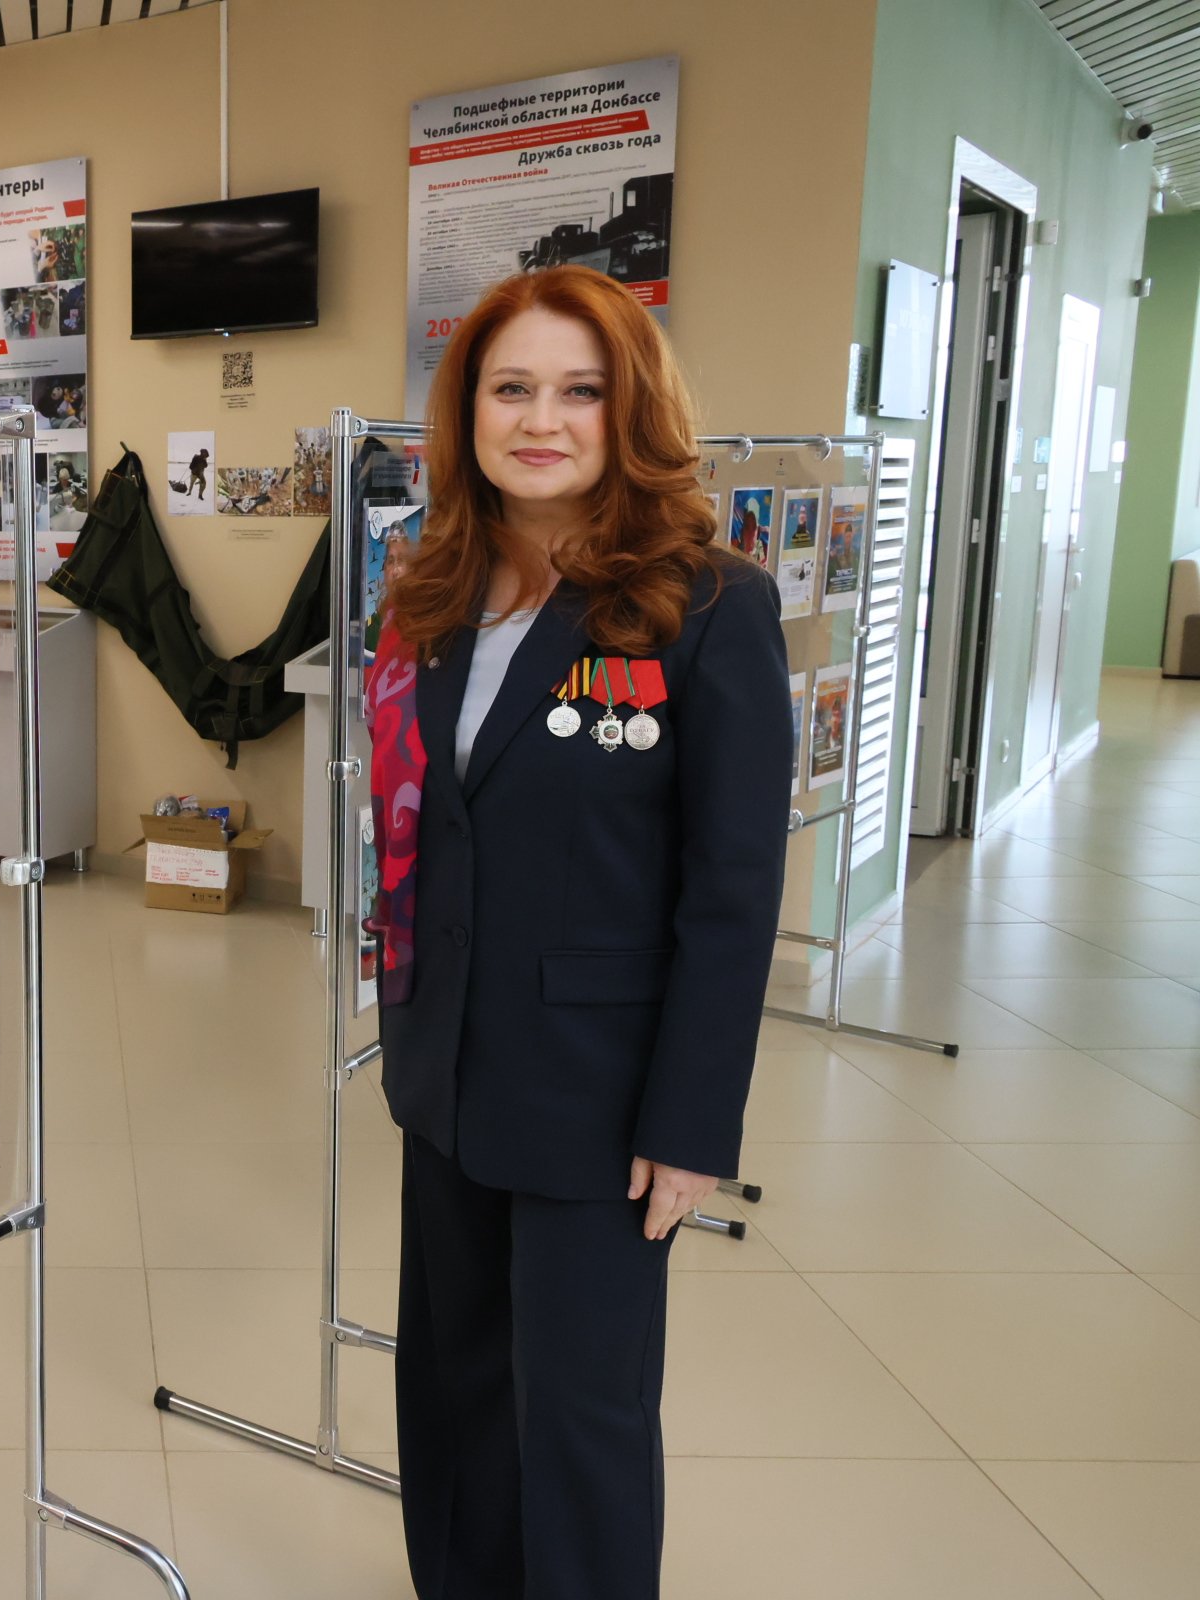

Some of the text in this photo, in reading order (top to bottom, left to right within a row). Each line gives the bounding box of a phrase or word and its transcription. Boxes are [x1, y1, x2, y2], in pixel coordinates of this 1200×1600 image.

[423, 114, 509, 139] Челябинской
[512, 106, 568, 125] области
[571, 104, 588, 115] на
[591, 91, 661, 114] Донбассе
[453, 80, 625, 118] Подшефные территории
[518, 142, 572, 166] Дружба
[576, 139, 624, 155] сквозь
[628, 132, 661, 149] года
[428, 167, 548, 191] Великая Отечественная война
